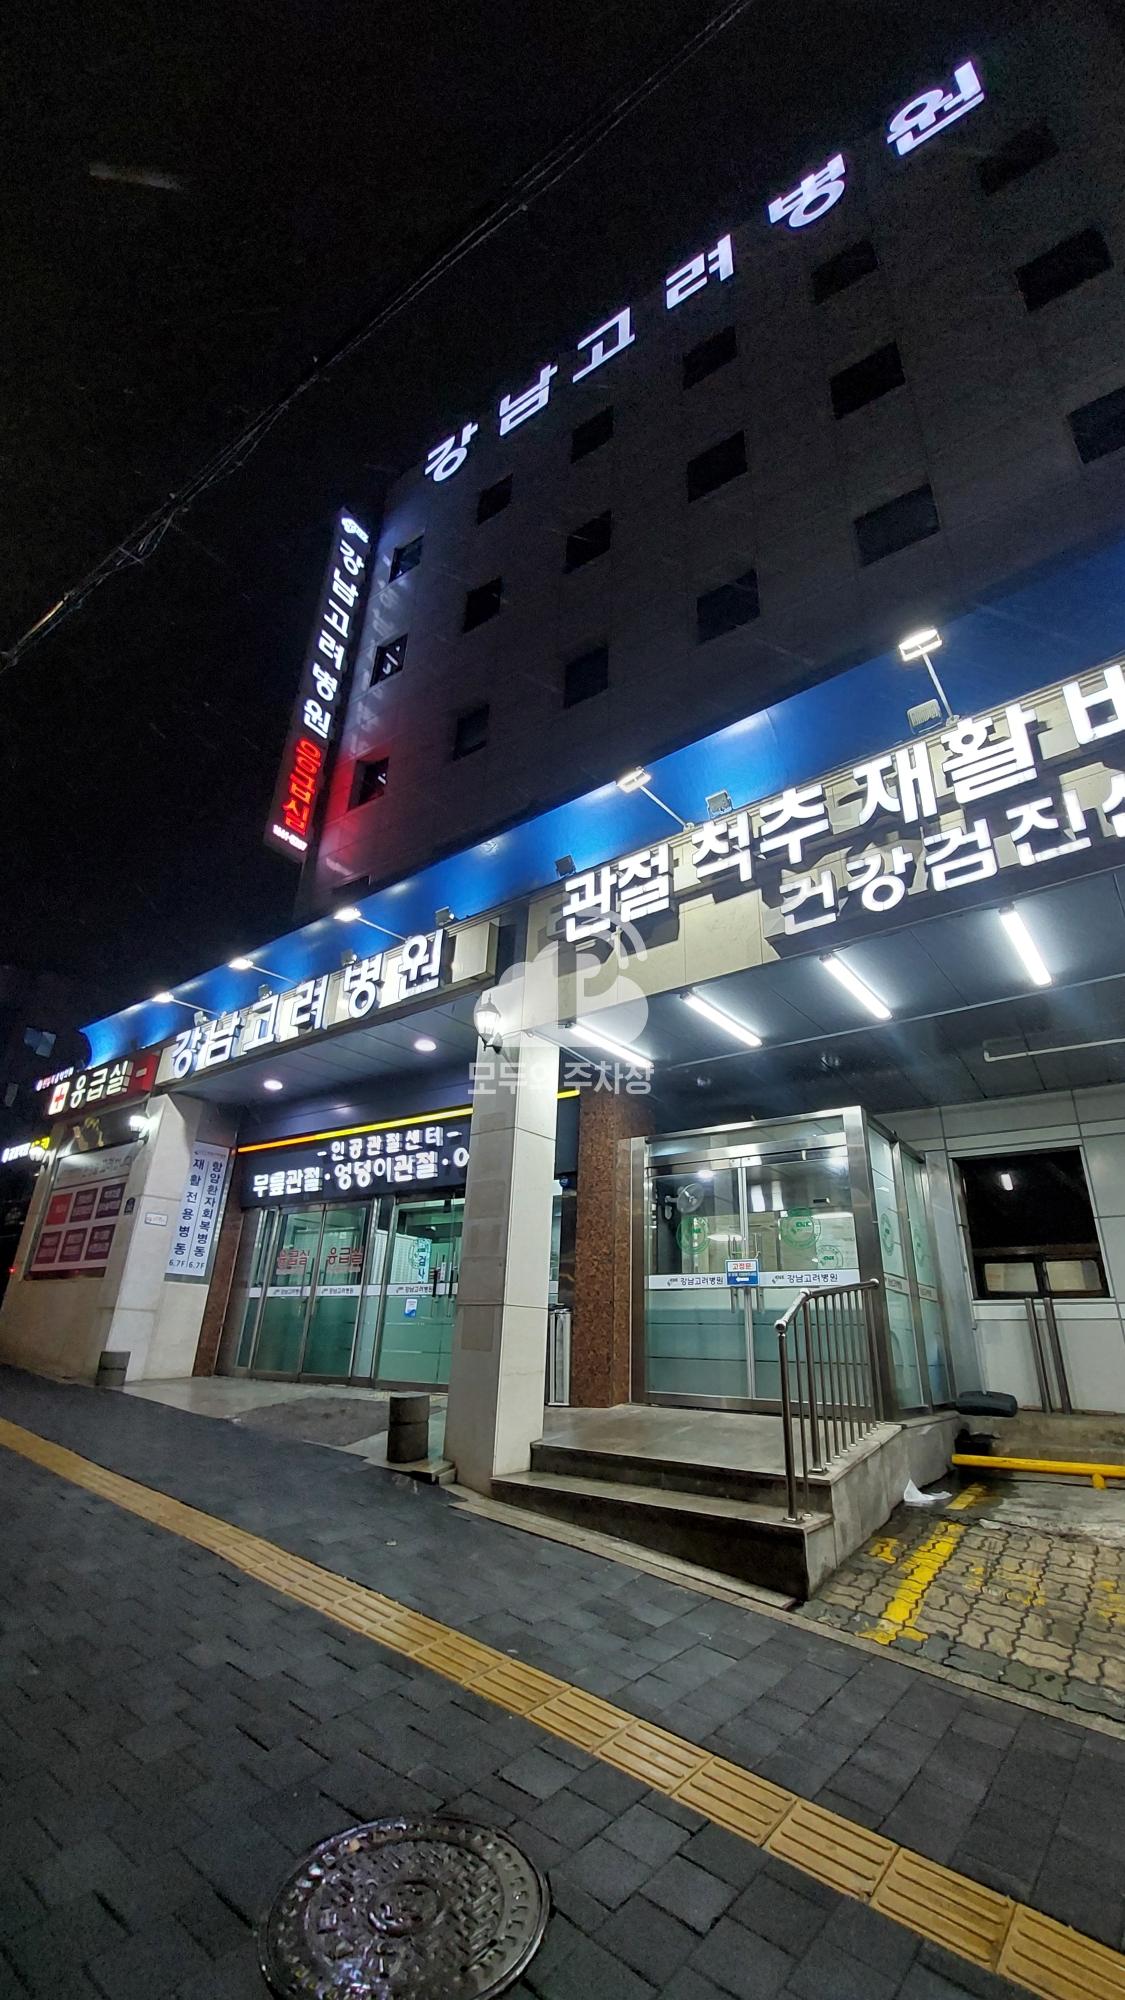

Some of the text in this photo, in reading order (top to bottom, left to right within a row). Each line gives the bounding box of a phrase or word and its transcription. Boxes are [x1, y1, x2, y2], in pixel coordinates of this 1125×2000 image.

[424, 60, 985, 482] 강남고려병원
[303, 539, 365, 739] 강남고려병원
[282, 738, 322, 837] 응급실
[562, 844, 673, 943] 관절
[691, 784, 830, 882] 척추
[852, 702, 1038, 824] 재활
[172, 928, 445, 1079] 강남고려병원
[69, 1060, 129, 1109] 응급실
[174, 1158, 205, 1256] 재활전용병동
[193, 1161, 223, 1258] 항암환자회복병동
[278, 1248, 310, 1270] 응급실
[327, 1246, 362, 1266] 응급실
[680, 1276, 724, 1286] 강남고려병원
[787, 1273, 839, 1285] 강남고려병원
